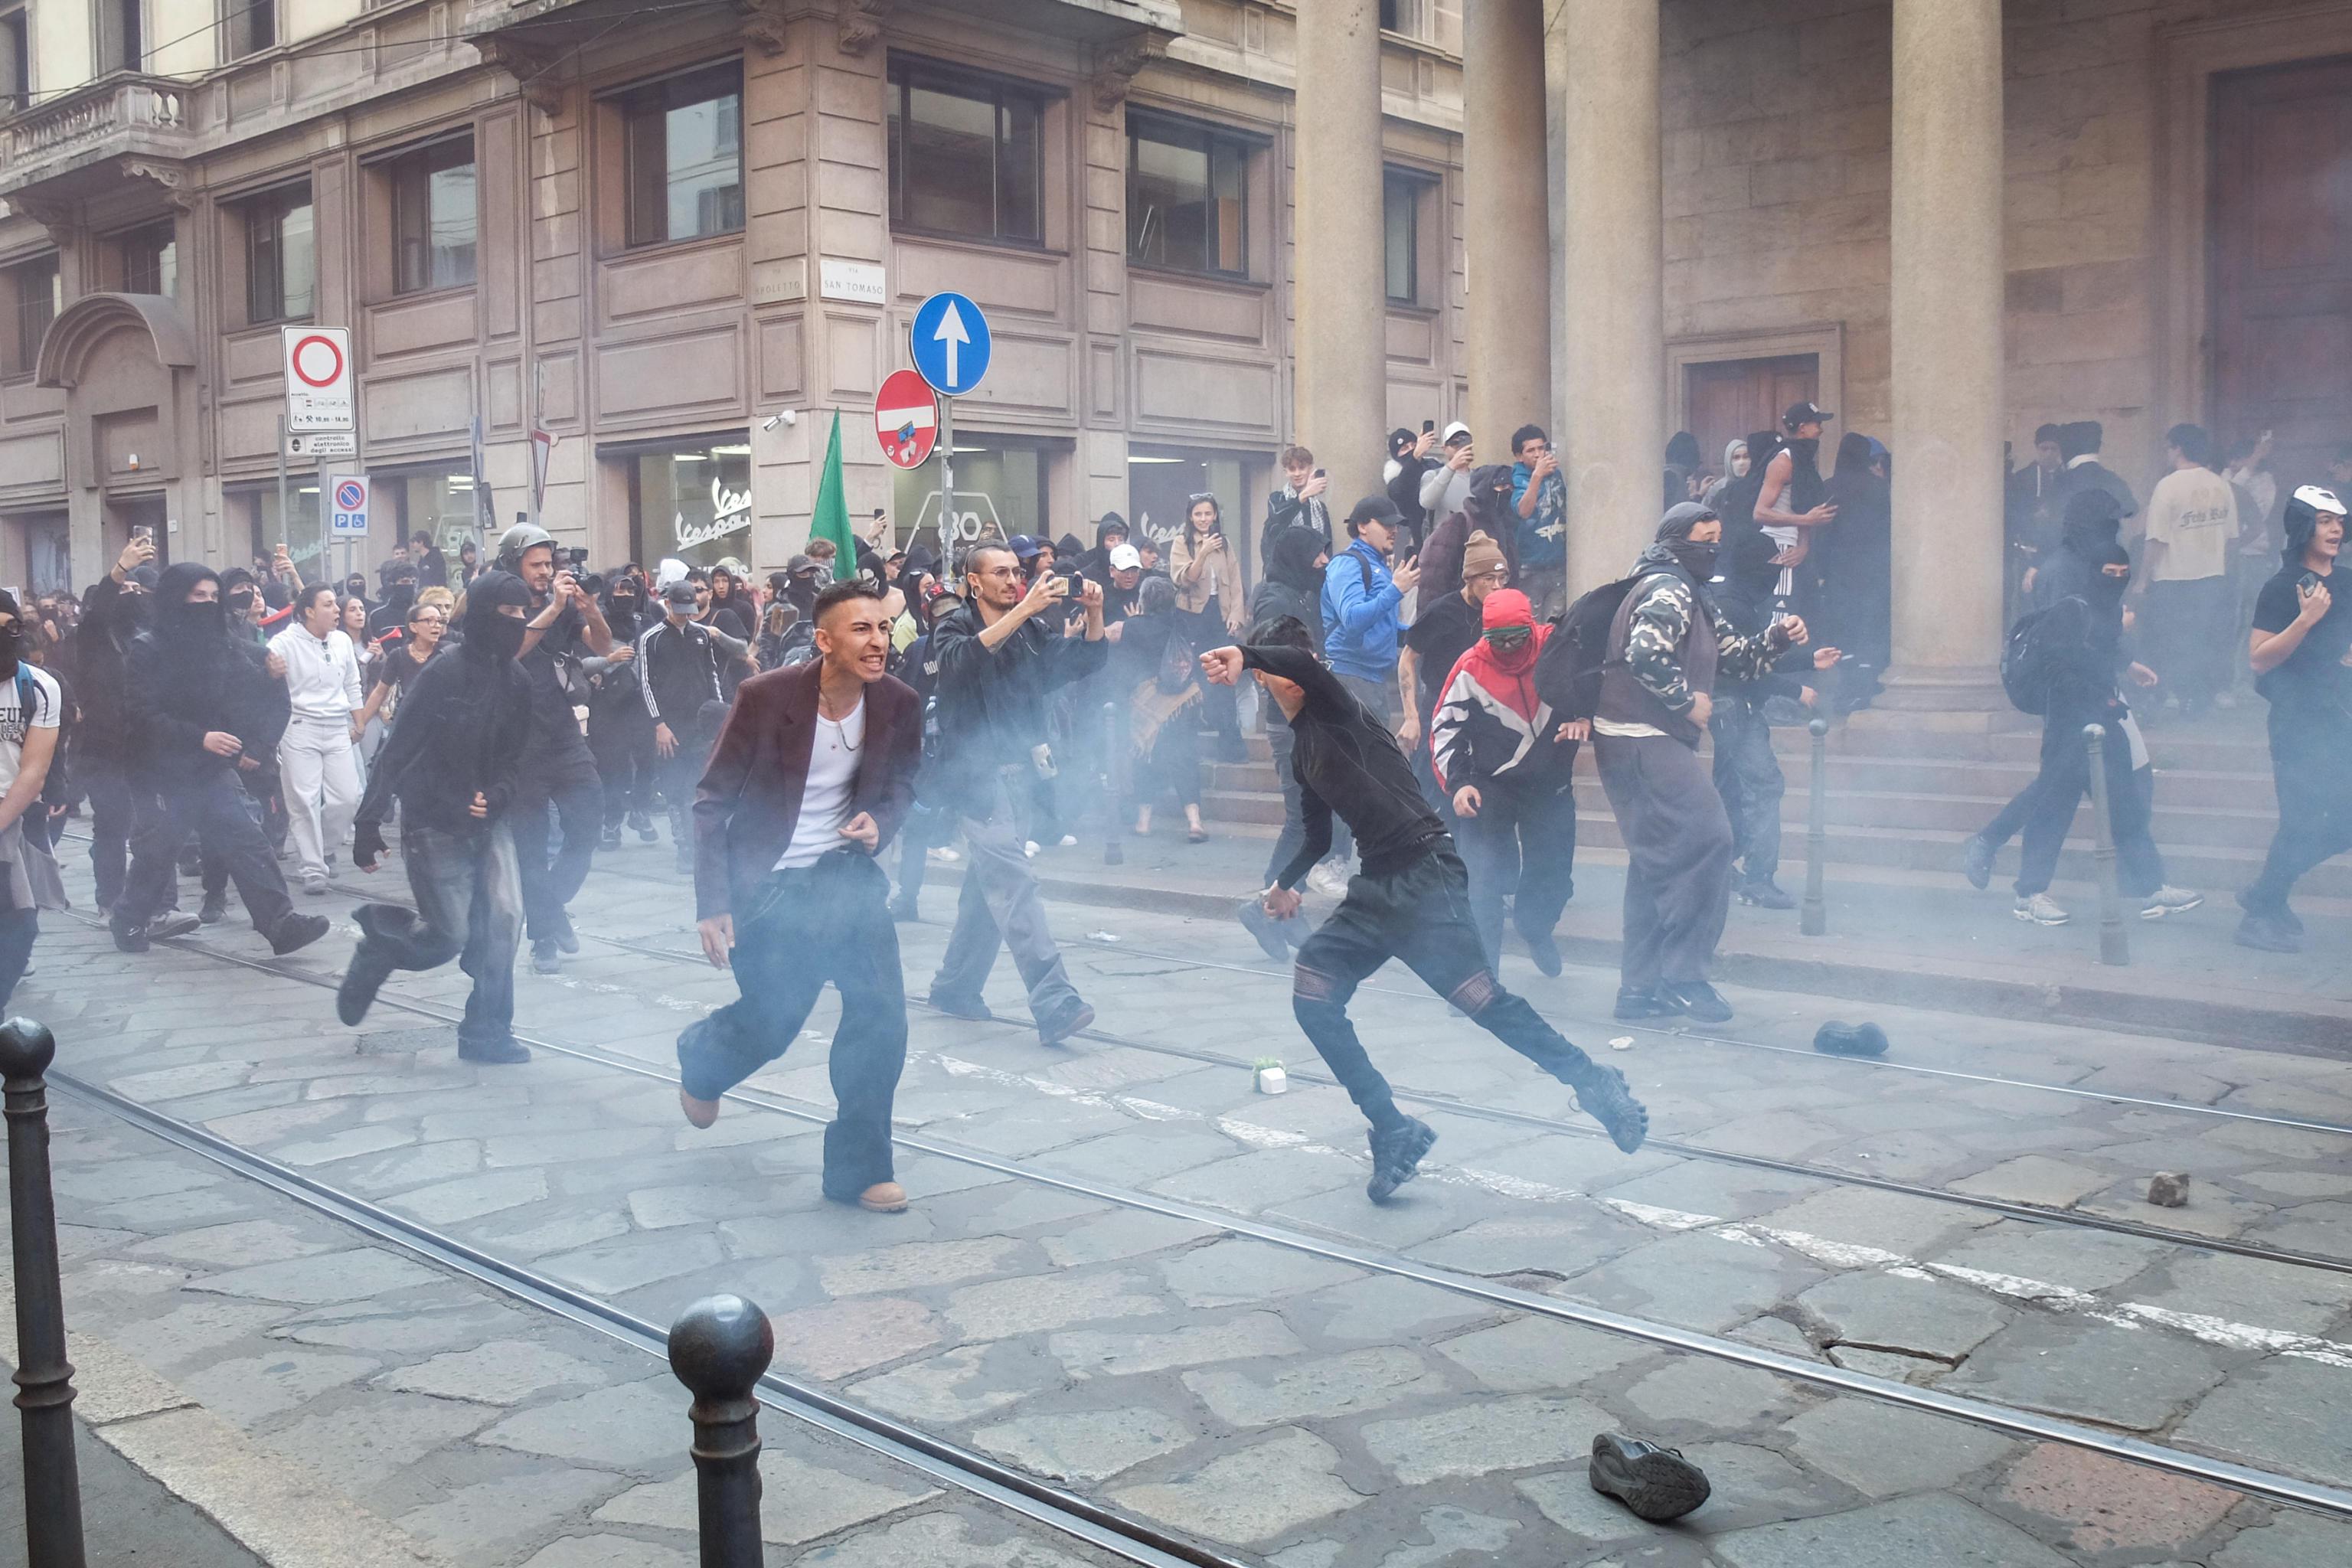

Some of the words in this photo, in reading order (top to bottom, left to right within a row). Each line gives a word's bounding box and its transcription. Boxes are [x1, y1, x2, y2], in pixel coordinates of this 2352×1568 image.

[824, 279, 841, 289] SAN
[847, 283, 884, 295] TOMASO
[338, 515, 346, 527] P
